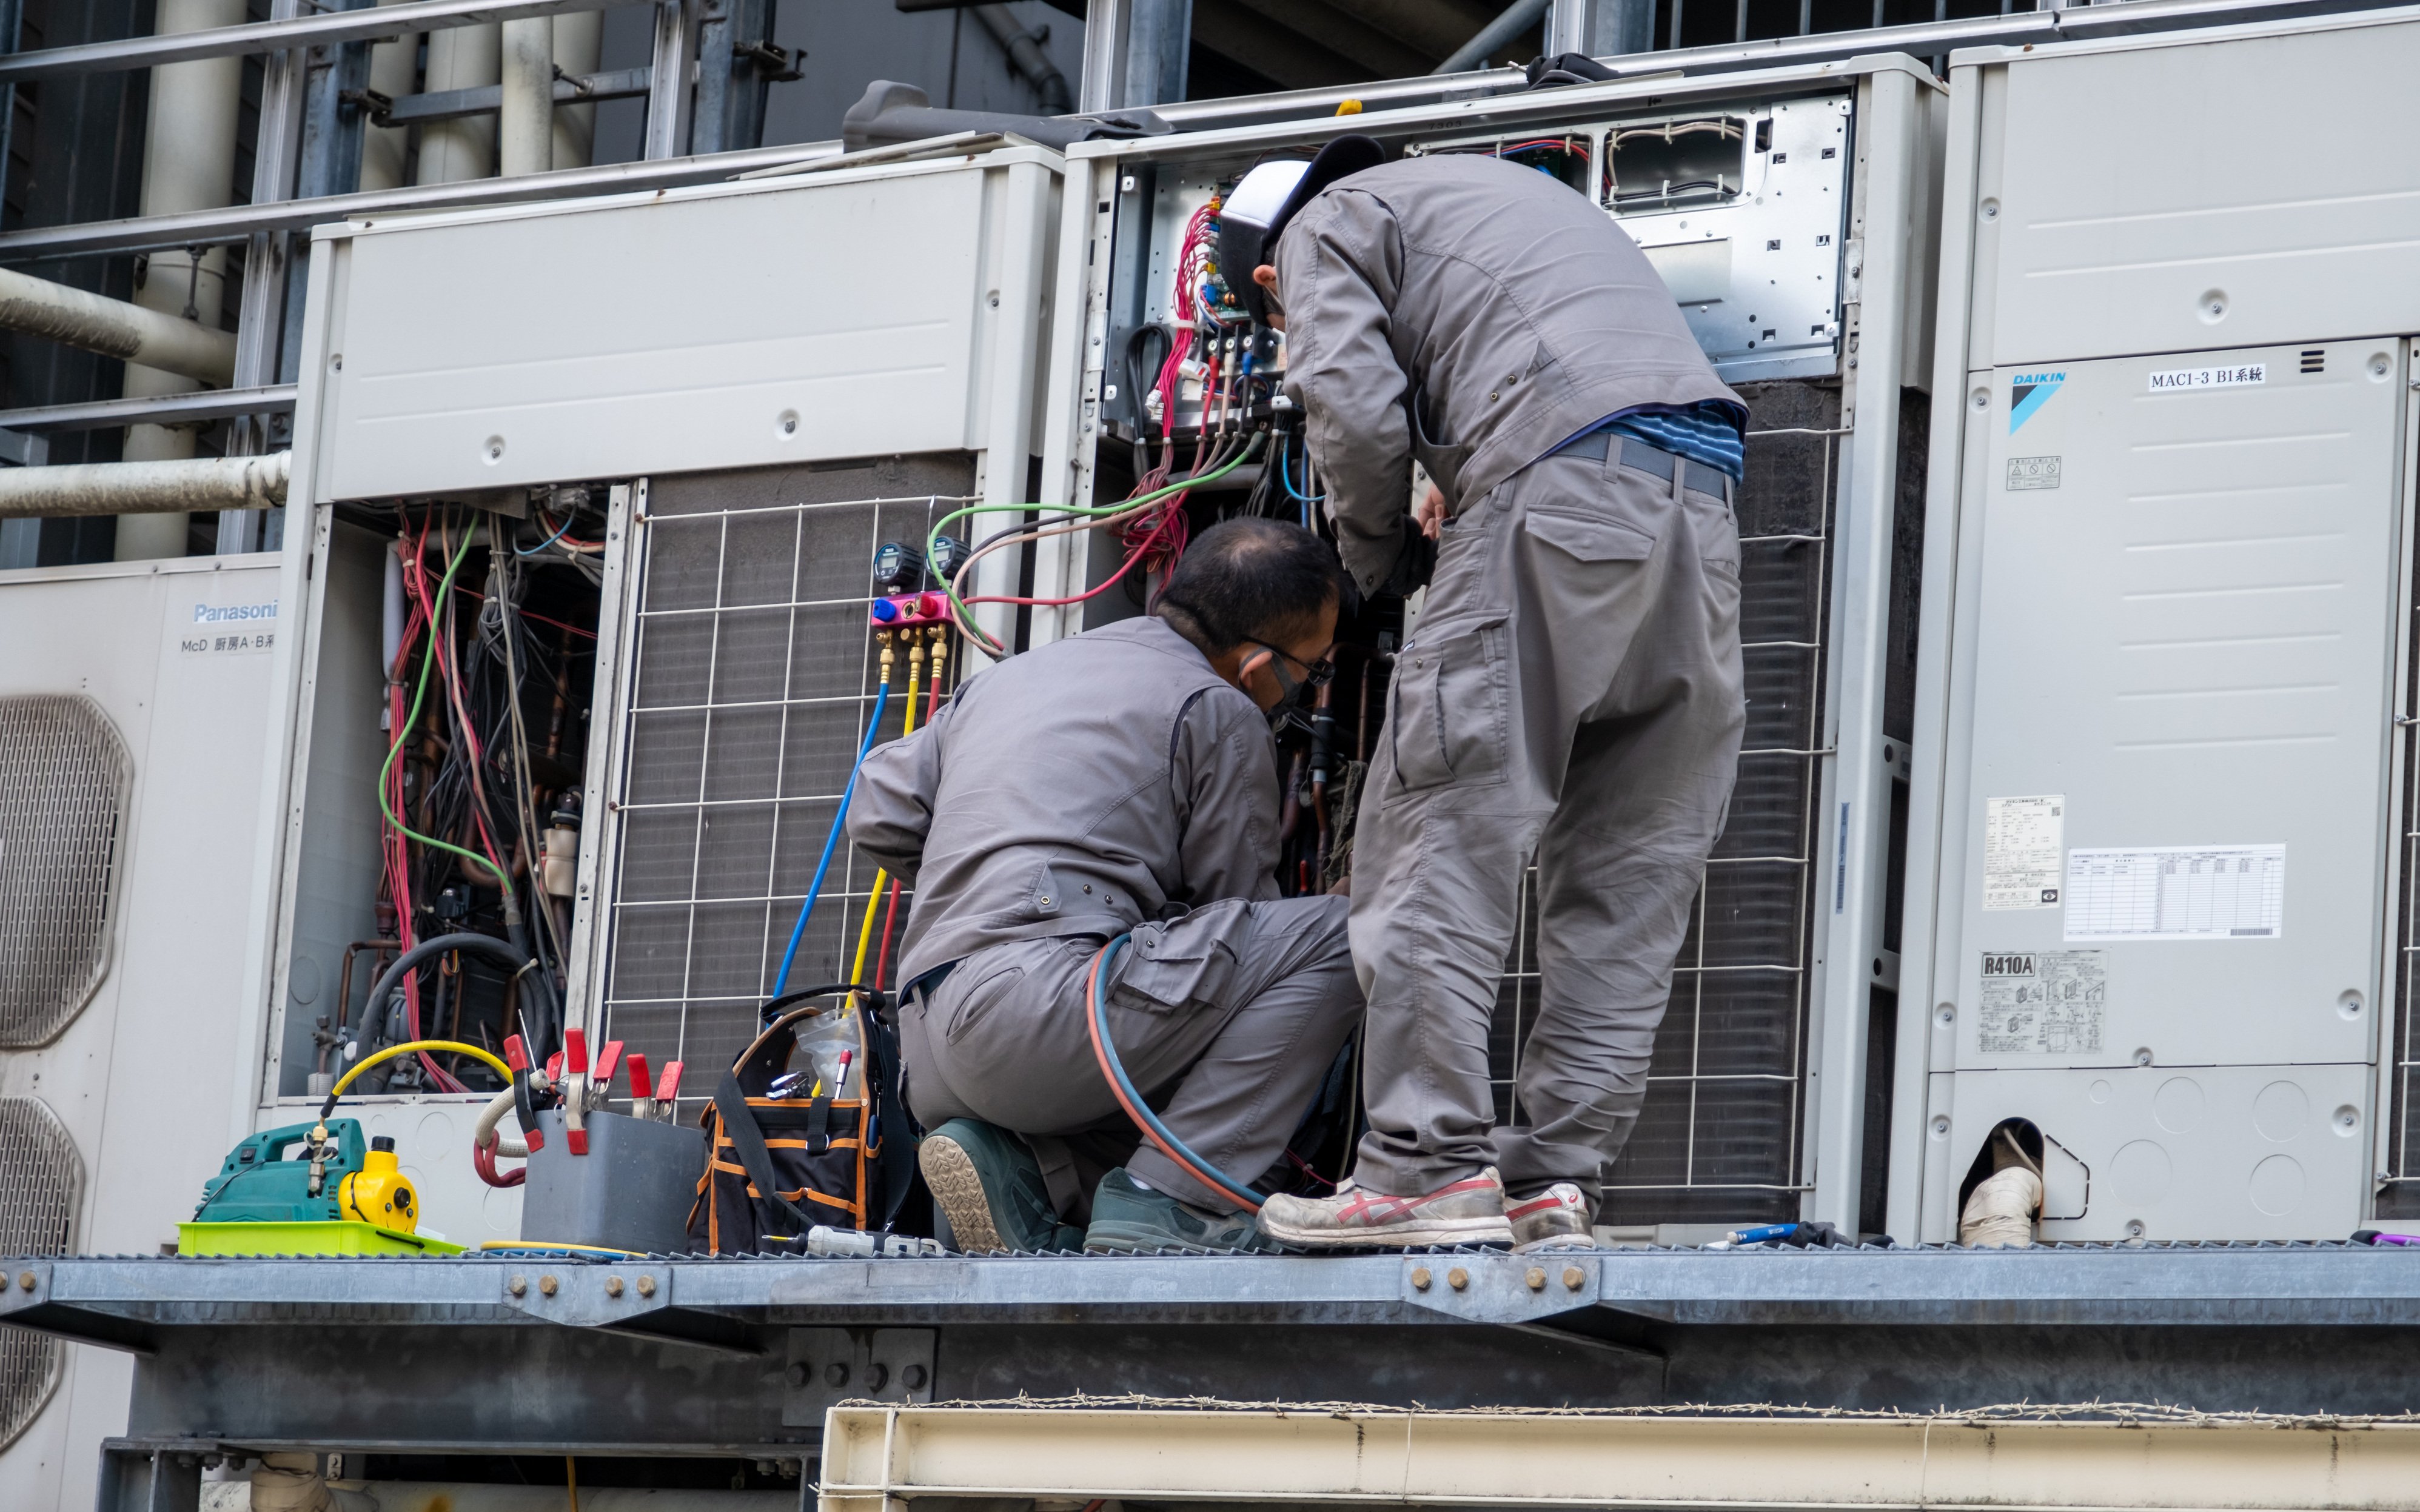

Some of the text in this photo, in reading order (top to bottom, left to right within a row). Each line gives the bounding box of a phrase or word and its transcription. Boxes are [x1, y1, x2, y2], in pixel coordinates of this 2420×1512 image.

[2013, 372, 2066, 384] DAIKIN
[2151, 367, 2262, 387] MAC1-3 B1系統
[194, 600, 278, 622] Panasoni
[181, 640, 207, 652] McD
[1985, 956, 2033, 974] R410A
